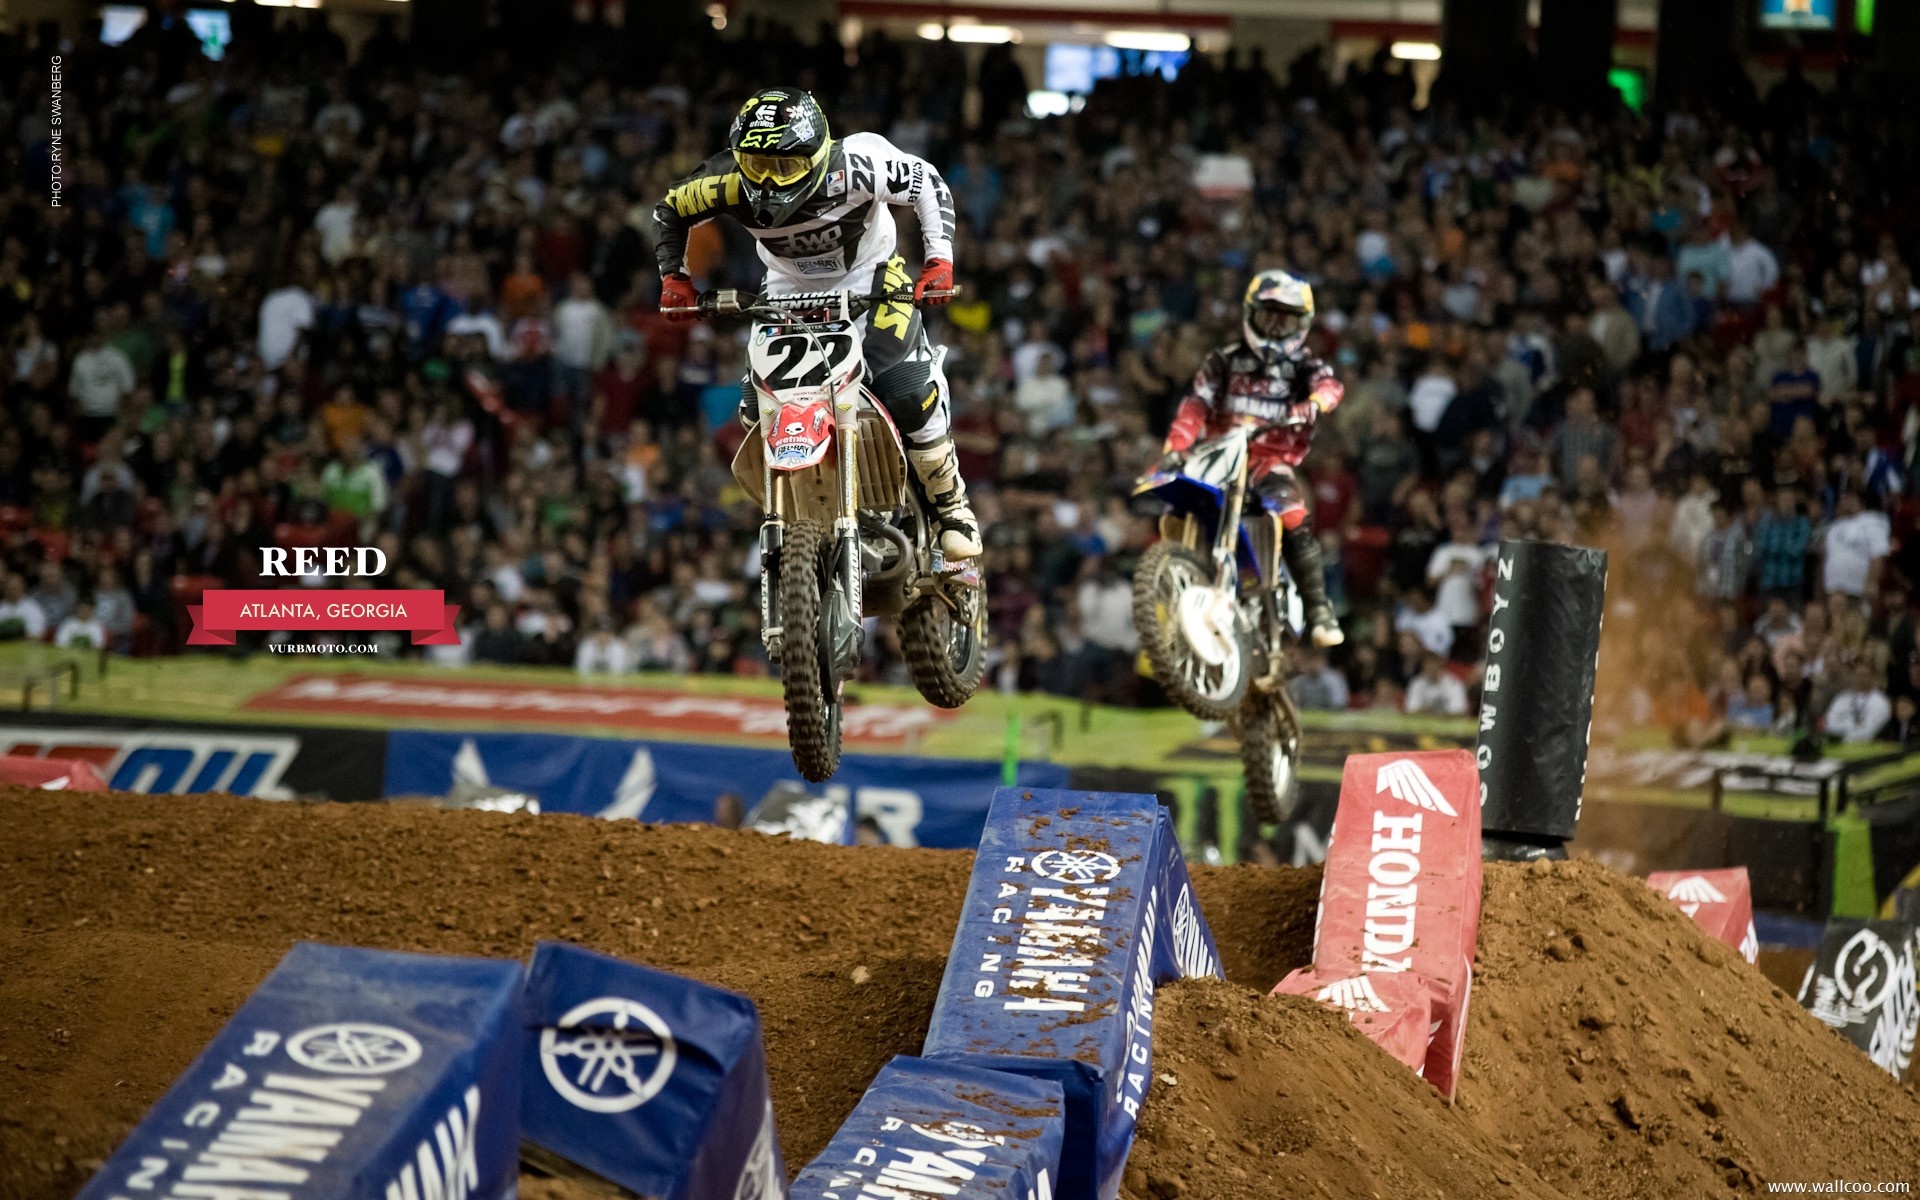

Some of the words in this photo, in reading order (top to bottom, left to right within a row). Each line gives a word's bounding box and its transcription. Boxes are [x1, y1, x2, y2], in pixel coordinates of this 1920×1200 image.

[849, 153, 876, 194] 22
[908, 161, 924, 203] etnies
[764, 333, 853, 392] 22
[107, 1030, 282, 1200] RACIN
